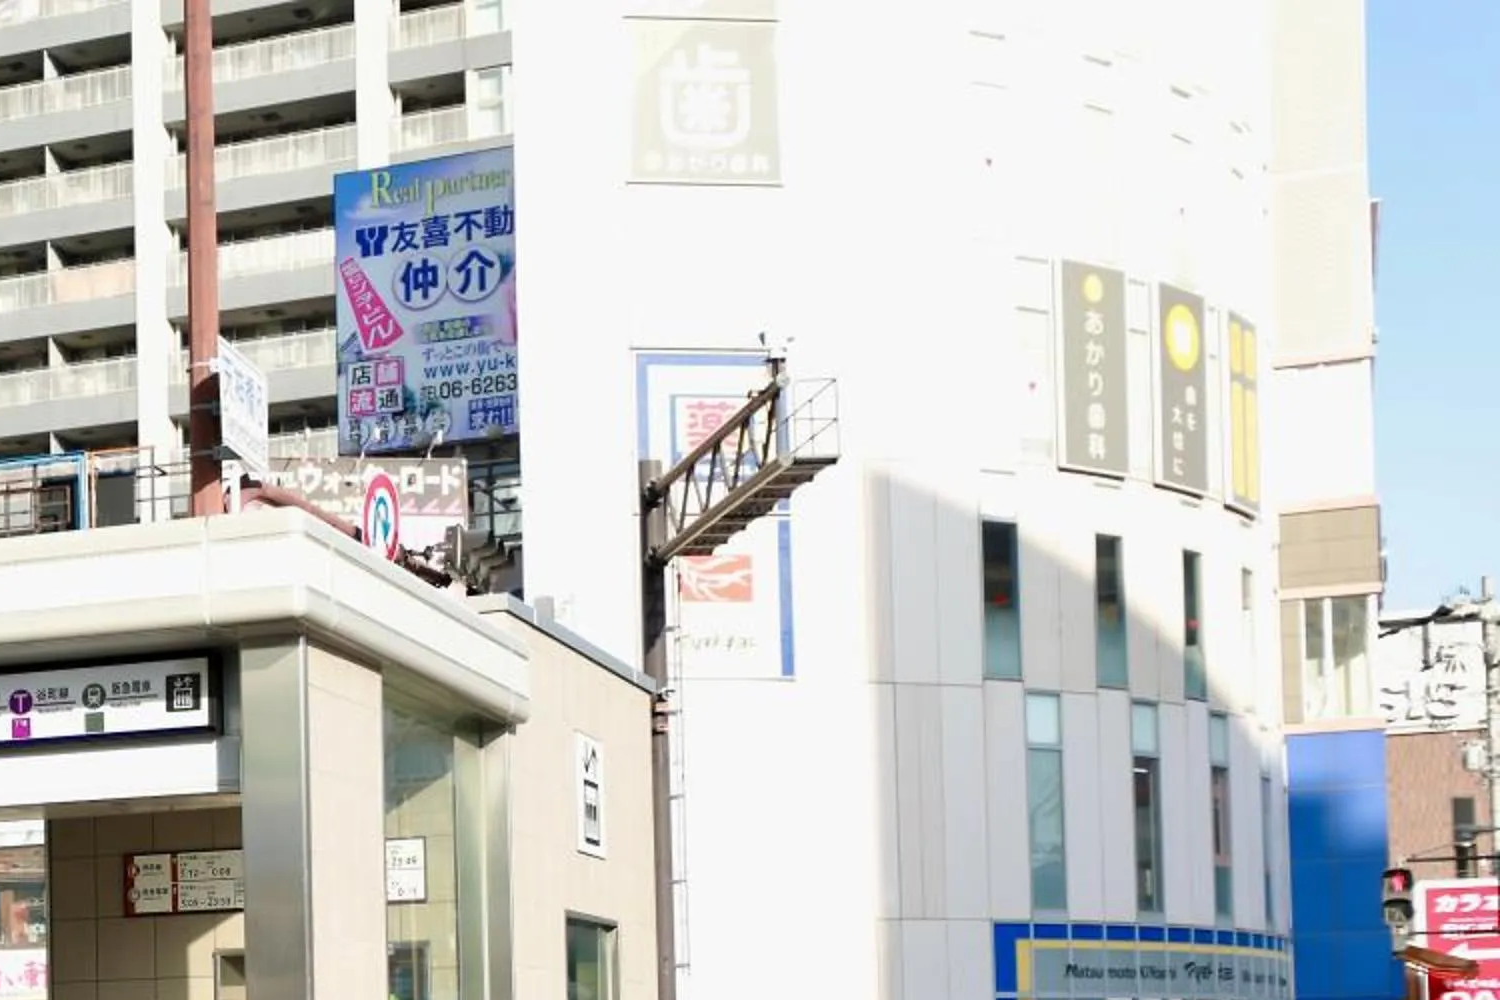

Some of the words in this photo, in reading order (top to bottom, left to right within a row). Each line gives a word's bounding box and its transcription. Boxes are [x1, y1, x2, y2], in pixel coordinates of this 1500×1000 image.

[401, 250, 495, 303] 仲介
[1084, 309, 1106, 461] あかり歯科
